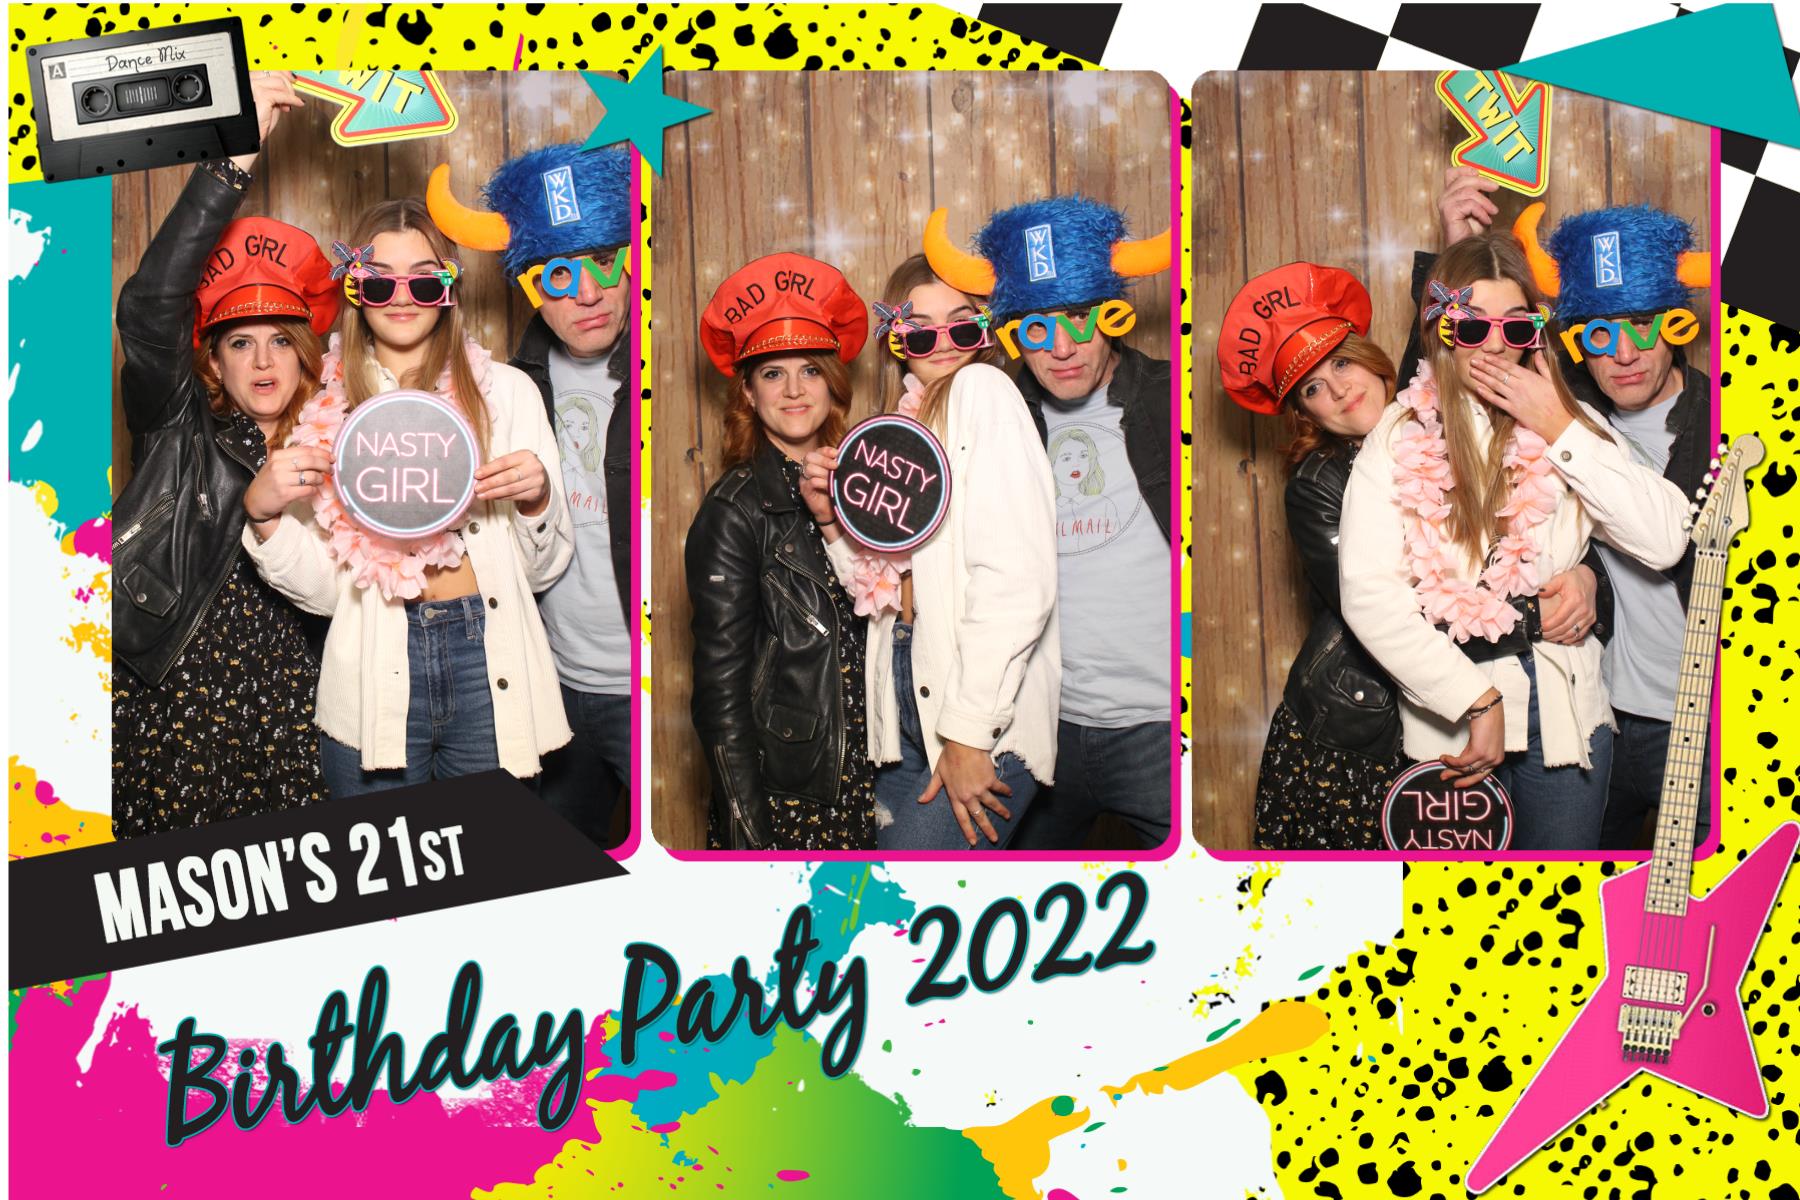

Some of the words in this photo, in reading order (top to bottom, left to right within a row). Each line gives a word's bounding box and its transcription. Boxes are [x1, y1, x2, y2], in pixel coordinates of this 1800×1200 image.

[313, 70, 425, 114] WIT
[1464, 70, 1535, 164] TWIT
[548, 170, 573, 221] WKD
[517, 244, 632, 309] rav
[1030, 229, 1049, 277] WKD
[1598, 236, 1615, 283] WKD
[724, 283, 765, 325] BAD
[995, 299, 1137, 360] rave
[1238, 328, 1261, 376] BAD
[1560, 308, 1700, 364] rave
[356, 431, 457, 458] NASTY
[853, 438, 938, 494] NASTY
[355, 466, 455, 504] GIRL
[843, 472, 915, 535] GIRL
[1072, 518, 1112, 535] MAIL
[1401, 791, 1491, 821] GIRL
[1403, 829, 1492, 850] NASTY
